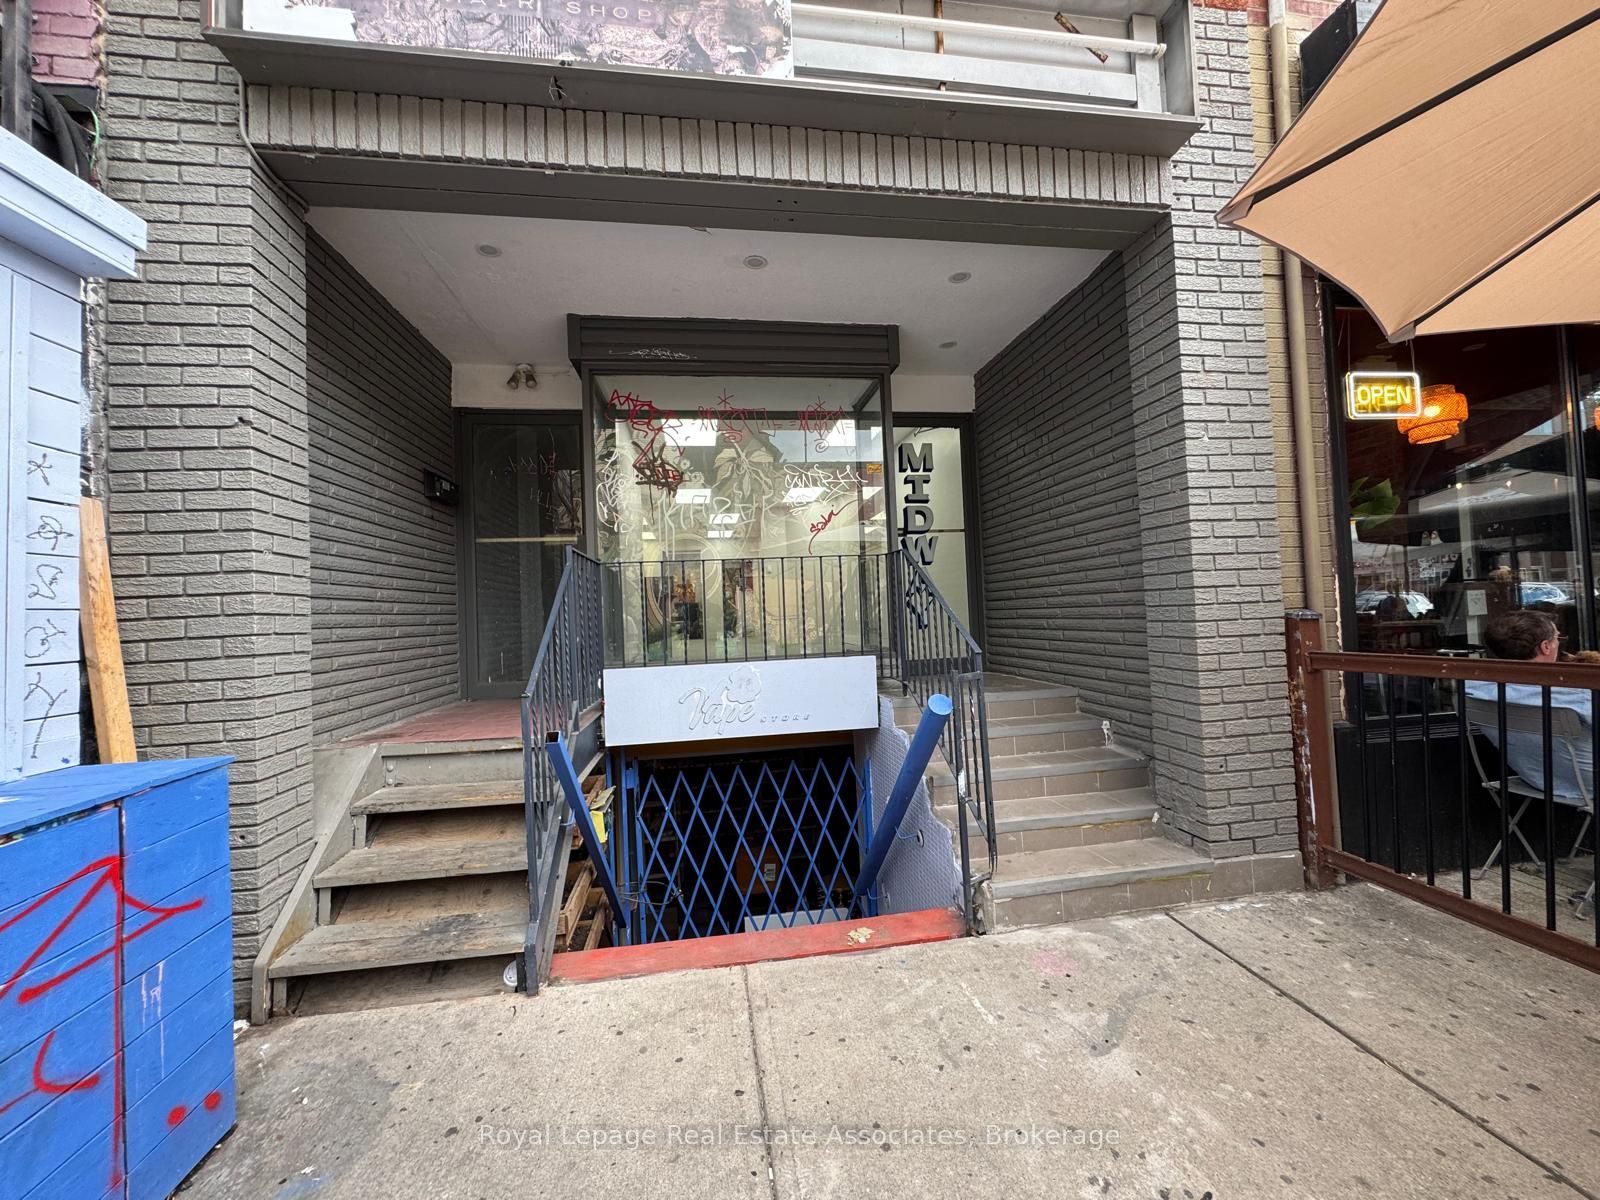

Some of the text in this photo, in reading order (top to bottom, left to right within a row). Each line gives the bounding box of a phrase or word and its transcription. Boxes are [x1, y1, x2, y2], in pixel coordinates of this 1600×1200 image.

[566, 3, 652, 20] SHOP
[1357, 385, 1411, 406] OPEN
[678, 686, 757, 736] Vape
